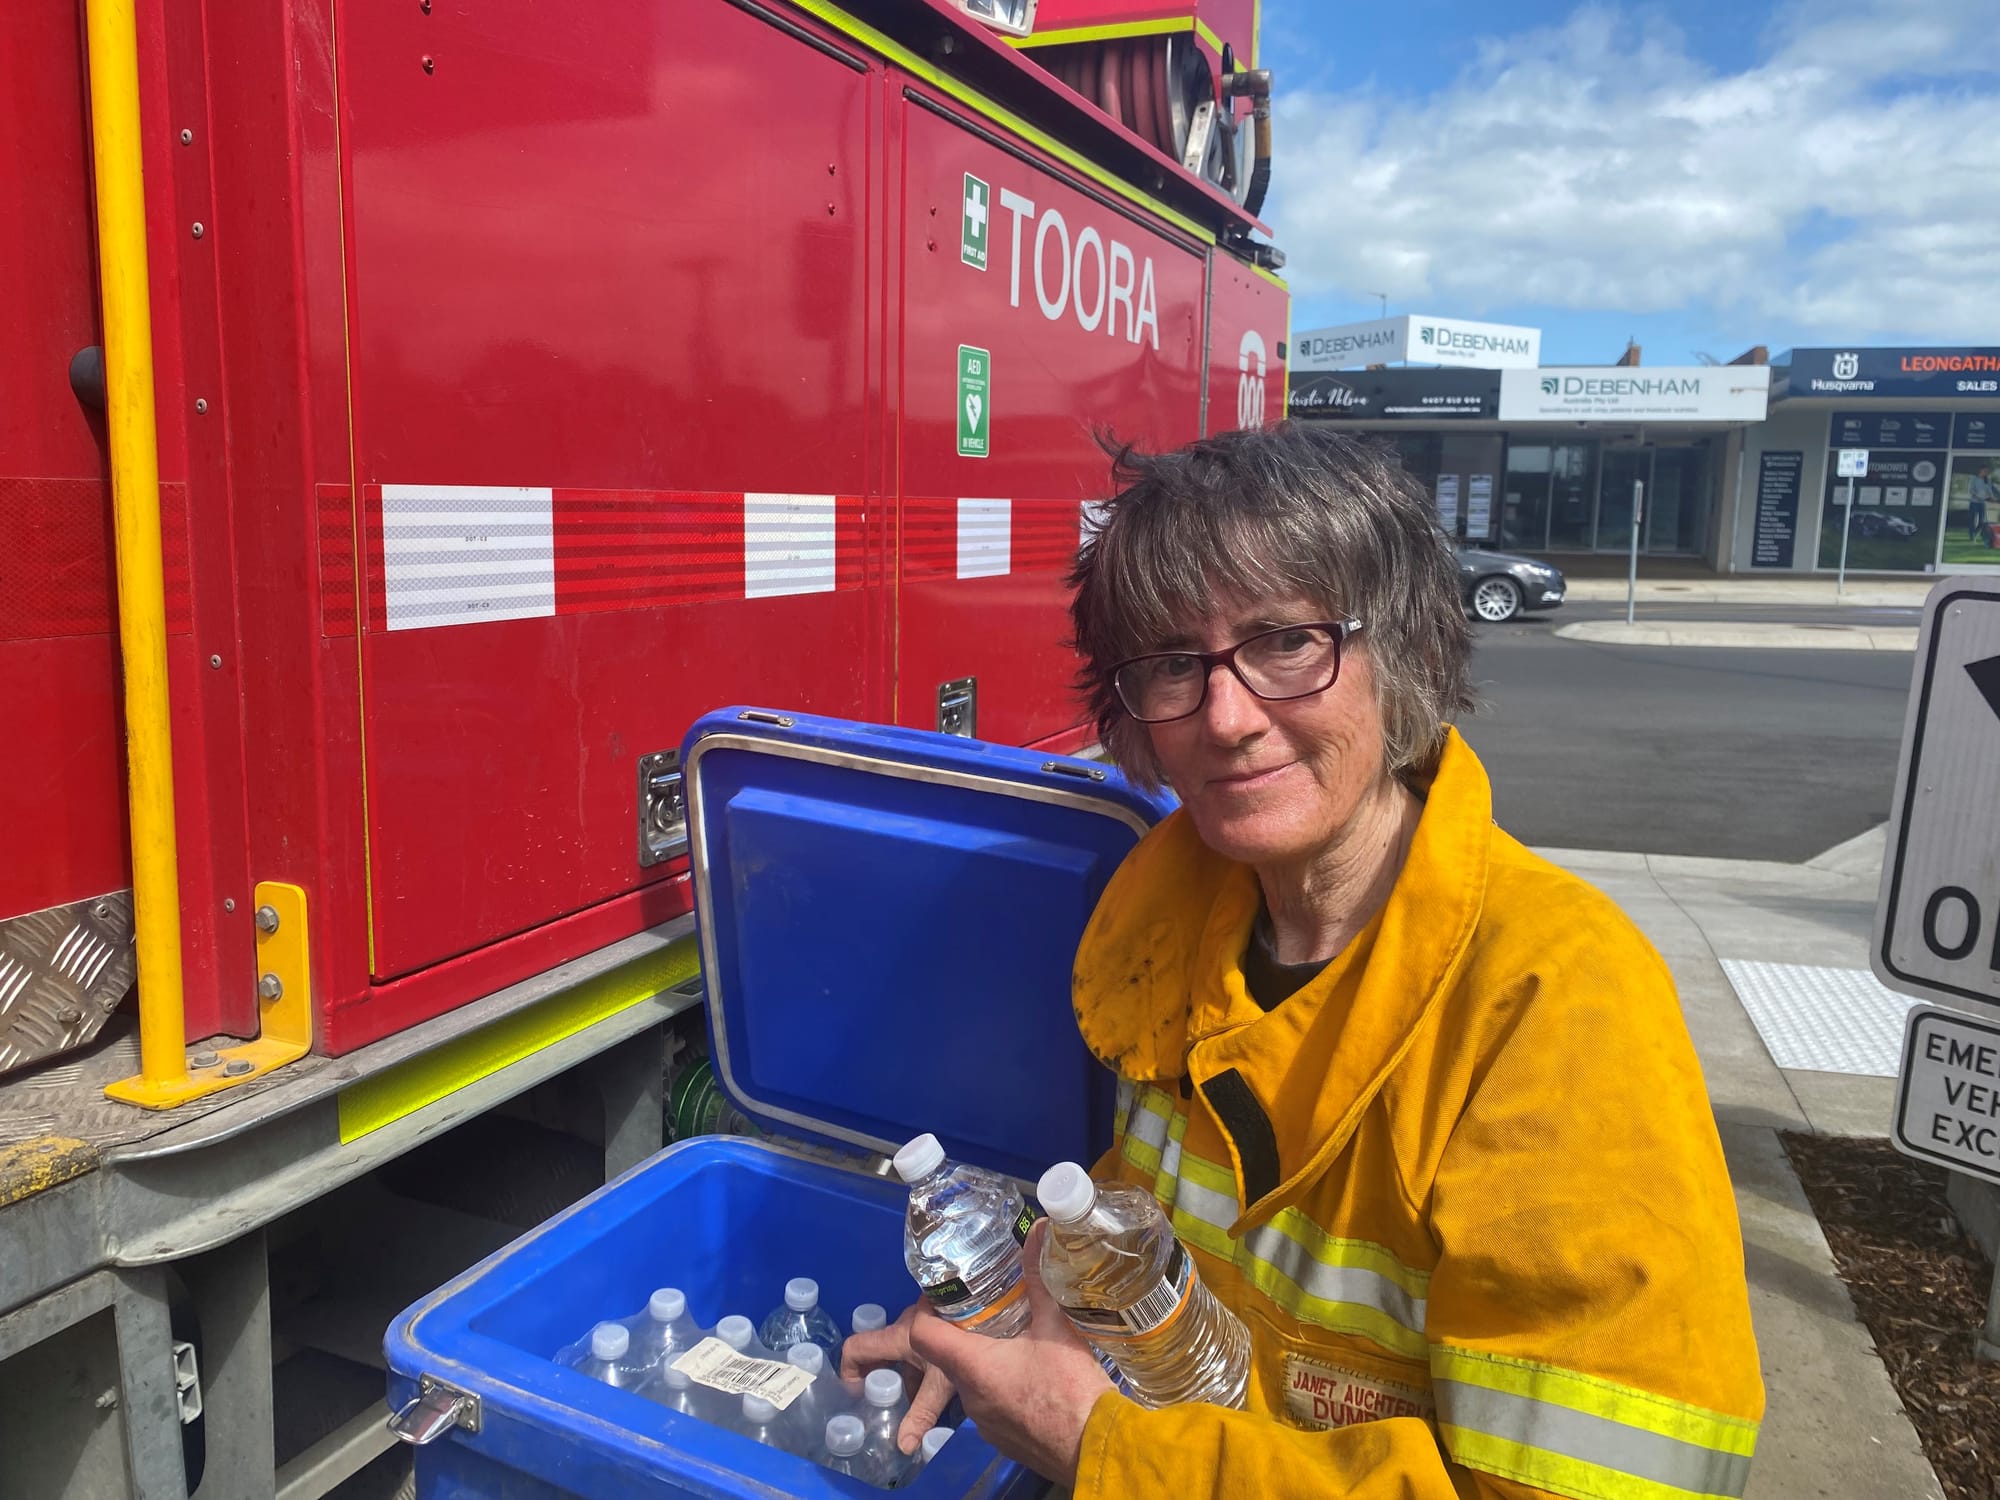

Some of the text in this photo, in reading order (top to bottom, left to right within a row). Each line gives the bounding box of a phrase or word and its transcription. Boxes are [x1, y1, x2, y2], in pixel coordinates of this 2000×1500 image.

[963, 244, 985, 262] FIRST AID
[1000, 187, 1160, 351] TOORA
[1311, 329, 1395, 357] DEBENHAM
[1437, 327, 1529, 356] DEBENHAM
[967, 358, 981, 375] AED
[1563, 376, 1700, 396] DEBENHAM
[1811, 379, 1874, 392] Husqvarna
[1956, 380, 1998, 391] SALES
[963, 437, 984, 449] IN VEHICLE
[1926, 1033, 2000, 1079] EME
[1932, 1113, 2000, 1160] EXC
[1293, 1371, 1337, 1399] JANET
